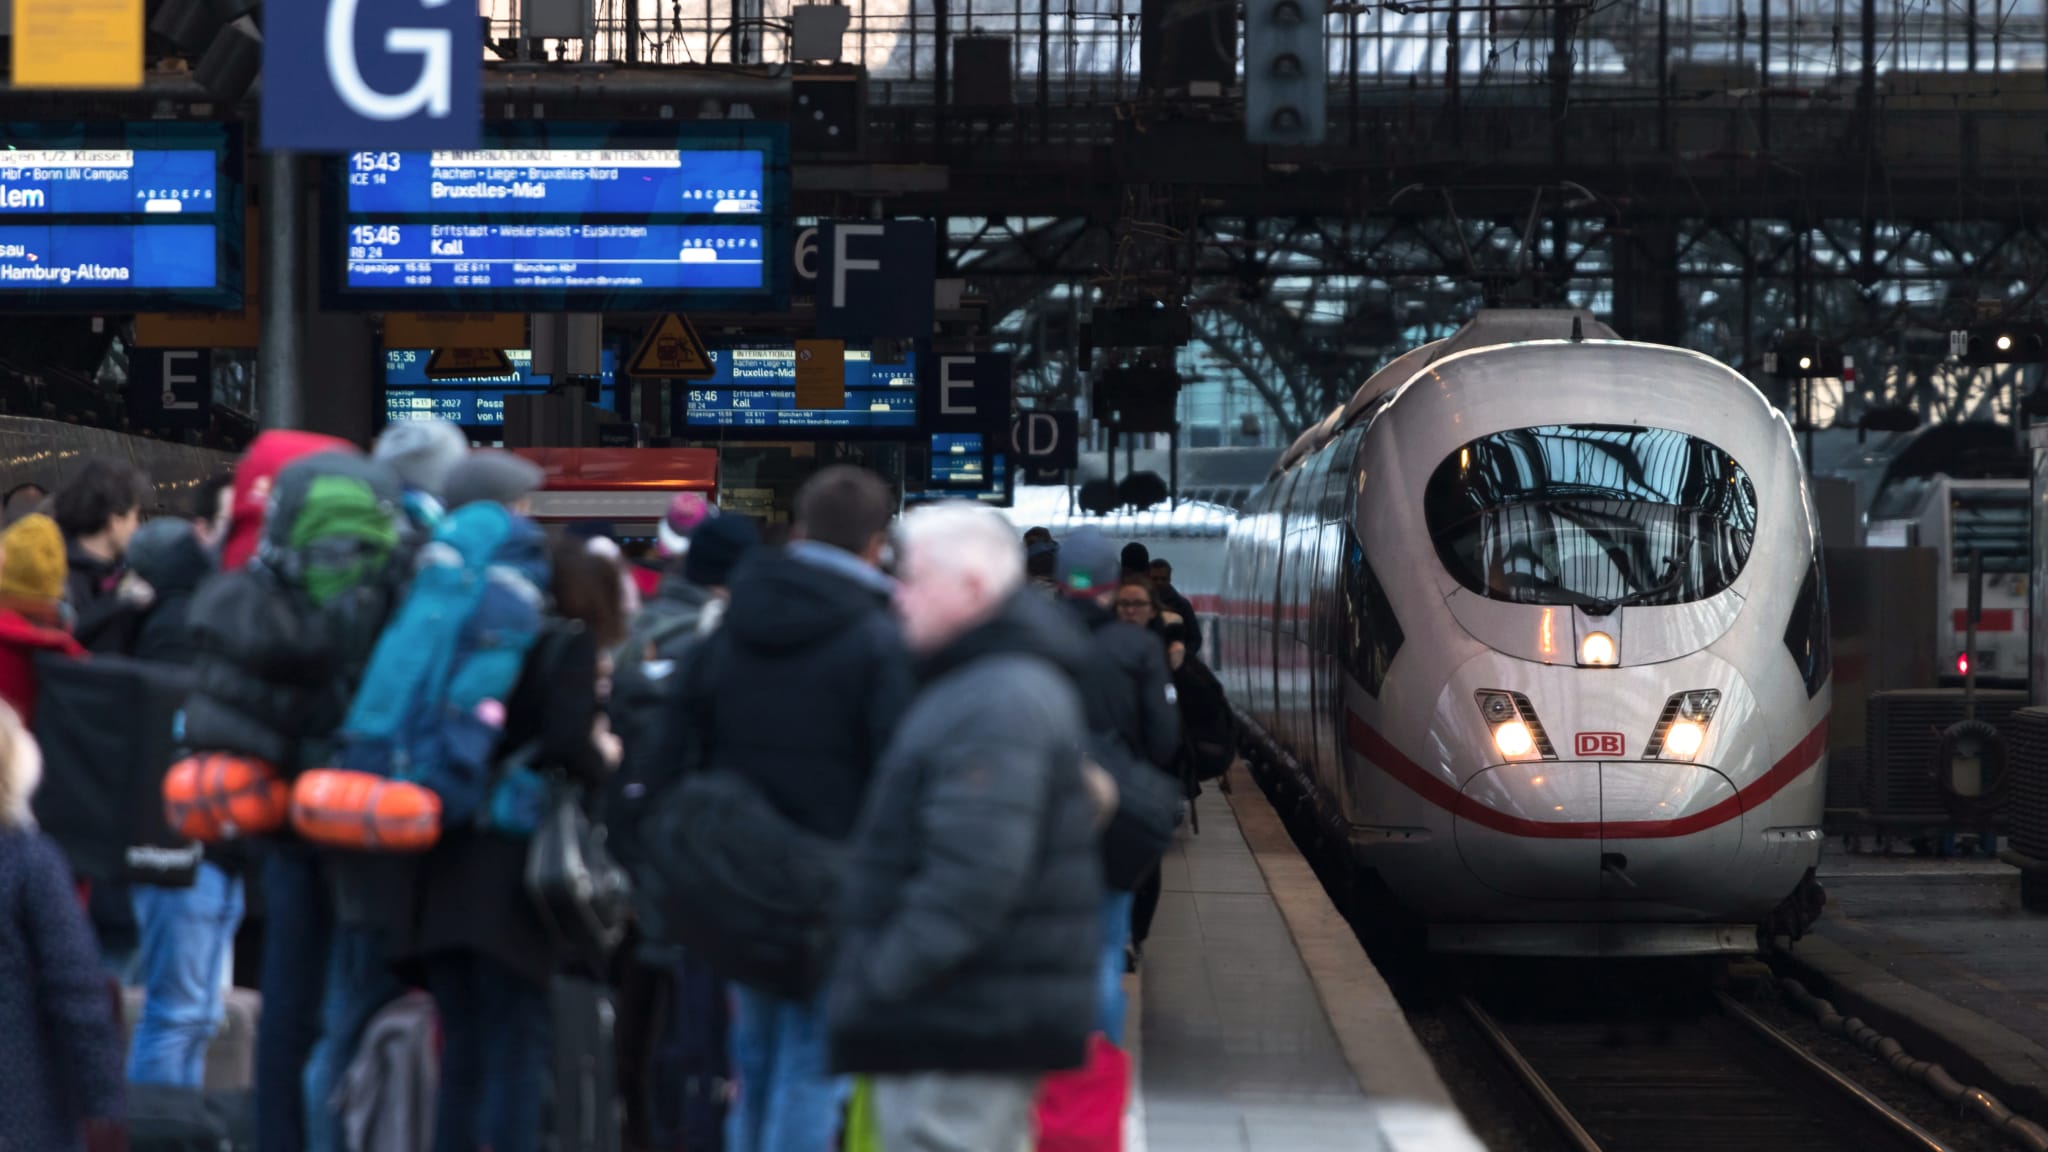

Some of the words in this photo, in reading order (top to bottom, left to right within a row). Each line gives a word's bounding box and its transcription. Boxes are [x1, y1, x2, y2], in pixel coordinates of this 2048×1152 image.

[325, 0, 452, 121] G
[352, 152, 401, 171] 15:43
[2, 168, 22, 180] Hbf
[33, 168, 63, 180] Bonn
[66, 168, 81, 180] UN
[83, 168, 129, 182] Campus
[350, 173, 369, 185] ICE
[373, 173, 387, 185] 14
[432, 168, 477, 180] Aachen
[487, 168, 518, 182] Liege
[528, 168, 618, 180] Bruxelles-Nord
[432, 182, 546, 198] Bruxelles-Midi
[352, 225, 401, 245] 15:46
[432, 225, 488, 236] Erftstadt
[500, 225, 571, 237] Weilerswist
[582, 225, 647, 237] Euskirchen
[368, 247, 383, 258] 24
[431, 239, 464, 255] Kall
[794, 228, 818, 279] 6
[1, 264, 129, 284] Hamburg-Altona
[454, 263, 469, 273] ICE
[833, 224, 885, 308] F
[454, 275, 469, 285] ICE
[534, 276, 563, 285] Berlin
[387, 351, 416, 362] 15:36
[162, 351, 200, 409] E
[940, 356, 977, 414] E
[441, 399, 461, 408] 2027
[689, 391, 718, 402] 15:46
[733, 400, 751, 408] Kall
[1028, 413, 1059, 455] D
[1581, 736, 1620, 752] DB
